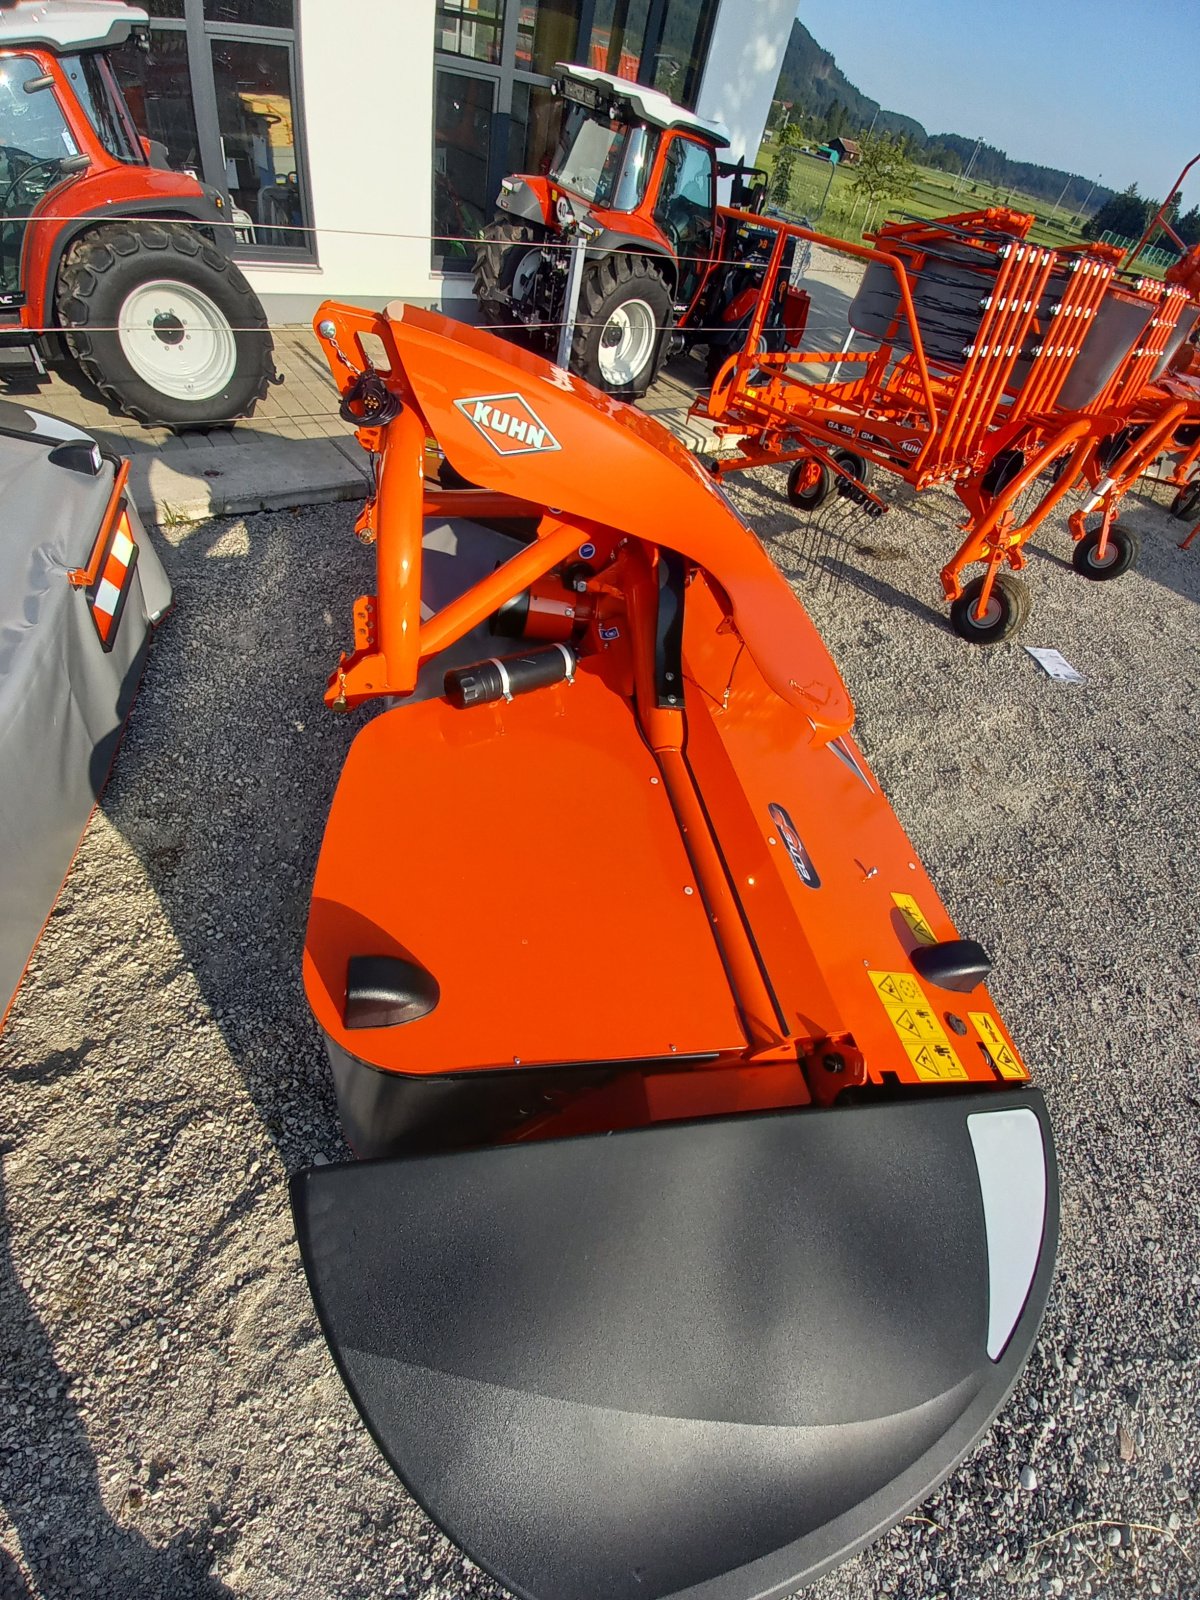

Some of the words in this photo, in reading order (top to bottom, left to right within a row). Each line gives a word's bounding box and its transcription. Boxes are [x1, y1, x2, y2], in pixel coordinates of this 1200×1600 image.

[558, 202, 567, 217] 40
[473, 401, 545, 449] KUHN
[827, 421, 839, 430] GA
[861, 431, 874, 442] GM
